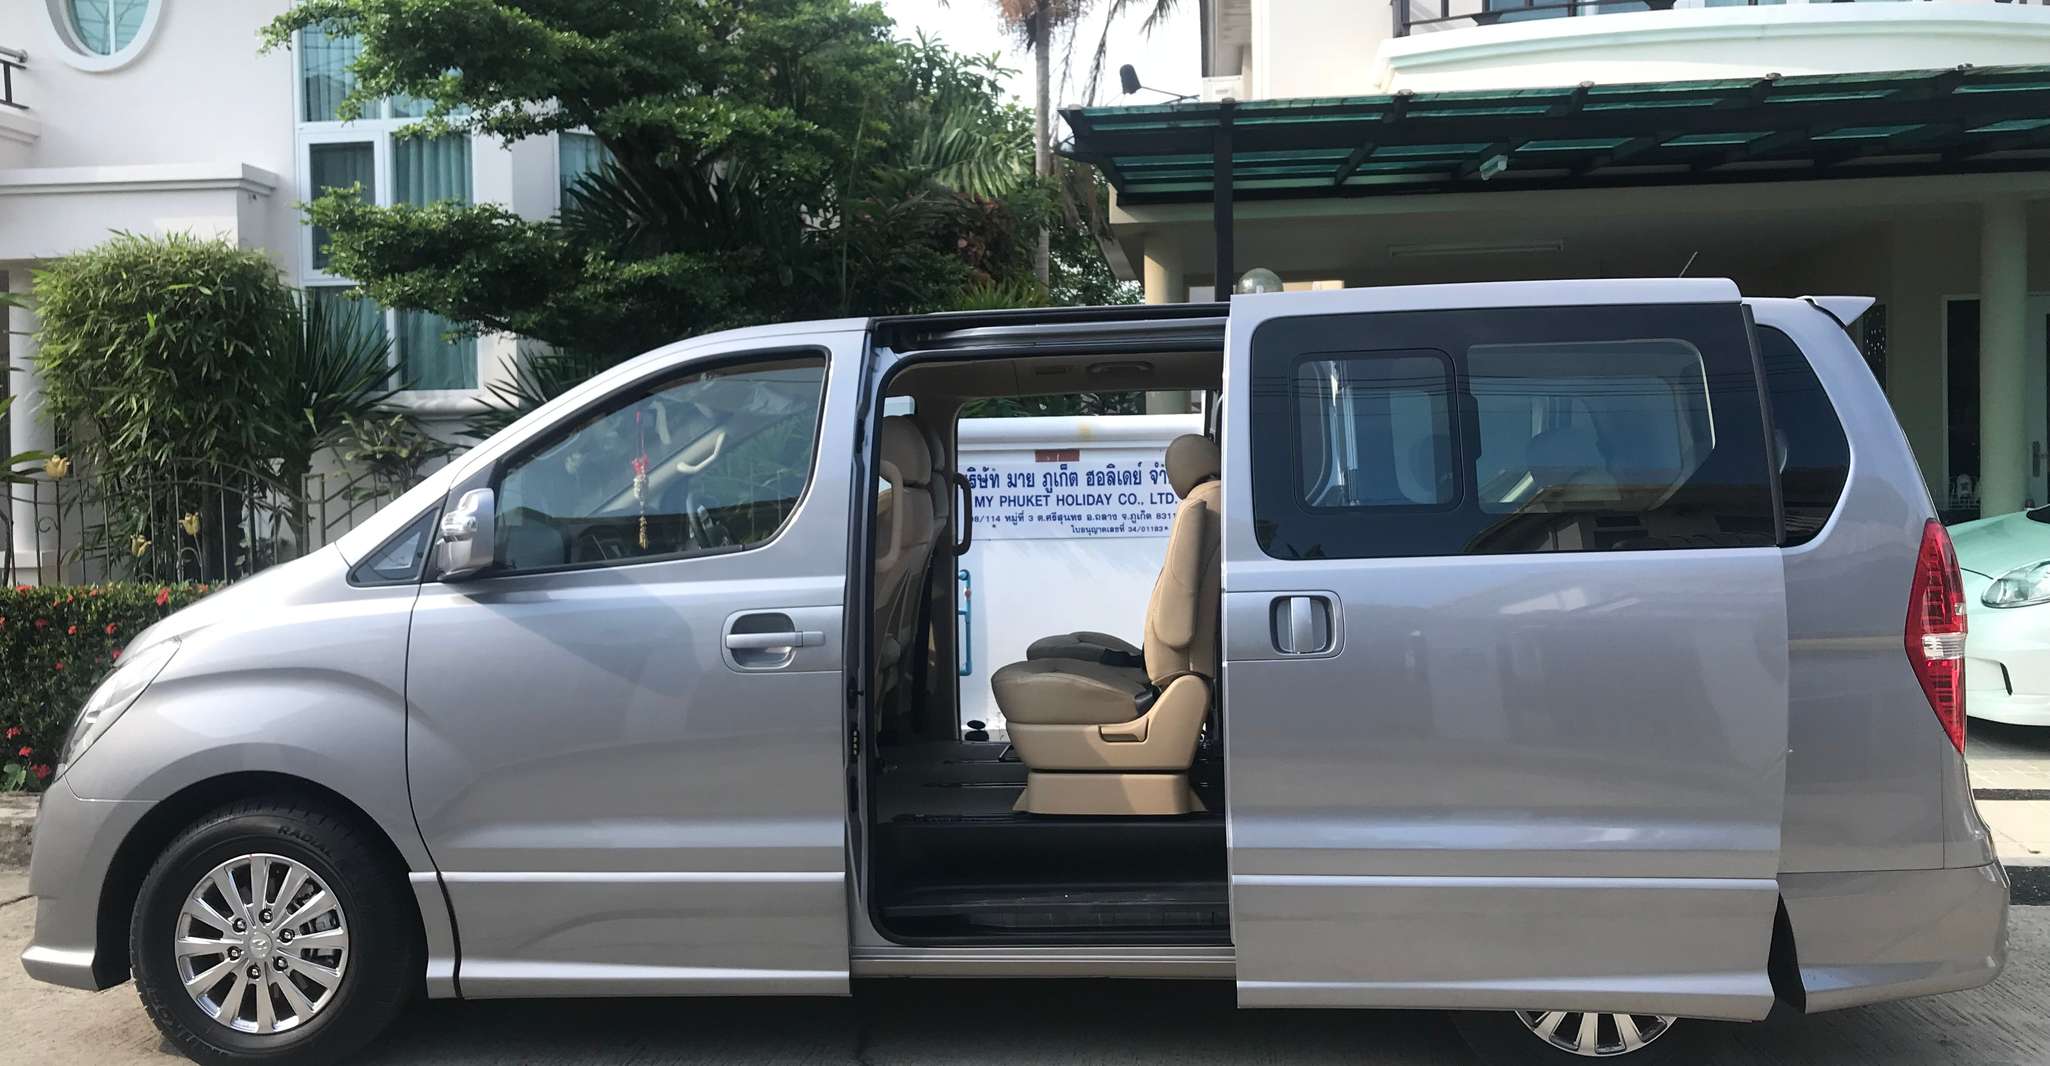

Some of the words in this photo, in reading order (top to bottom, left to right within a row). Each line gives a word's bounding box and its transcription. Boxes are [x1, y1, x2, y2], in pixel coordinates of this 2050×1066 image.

[963, 466, 1000, 490] ริษัท
[1007, 472, 1035, 489] มาย
[1042, 463, 1079, 493] ภูเก็ต
[1086, 461, 1143, 487] ฮอลิเดย์
[974, 495, 994, 508] MY
[999, 494, 1051, 508] PHUKET
[1056, 493, 1113, 507] HOLIDAY
[1149, 492, 1178, 505] LTD.
[971, 514, 1001, 523] 8/114
[1028, 514, 1034, 522] 3
[278, 825, 332, 859] RADIAL
